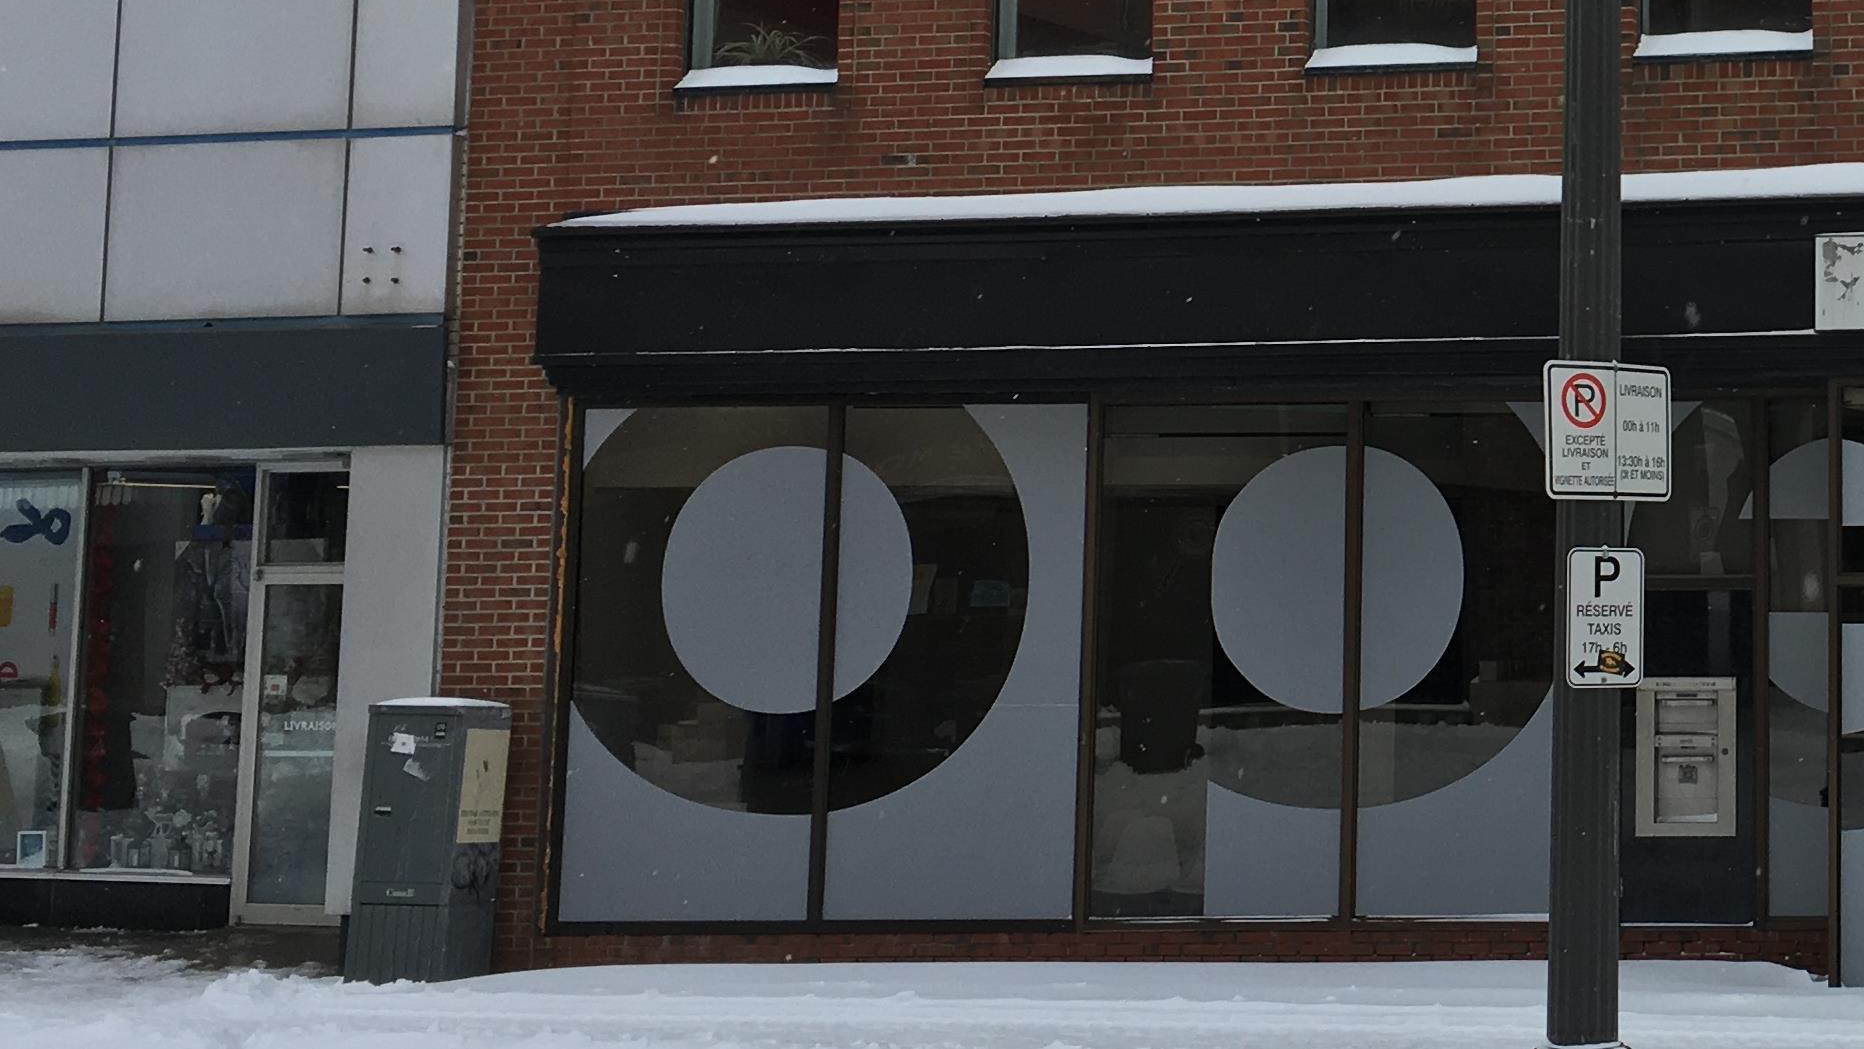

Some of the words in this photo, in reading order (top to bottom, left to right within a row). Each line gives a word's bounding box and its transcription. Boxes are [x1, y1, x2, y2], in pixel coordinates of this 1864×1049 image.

[1620, 384, 1663, 398] LIVRAISON
[1646, 421, 1660, 432] 11h
[1562, 448, 1609, 458] LIVRAISON
[1582, 462, 1591, 470] ET
[1630, 470, 1639, 479] ET
[1594, 556, 1620, 598] P
[1576, 601, 1633, 617] RÉSERVÉ
[1587, 623, 1622, 635] TAXIS
[1582, 642, 1602, 653] 17h
[1613, 642, 1628, 653] 6h
